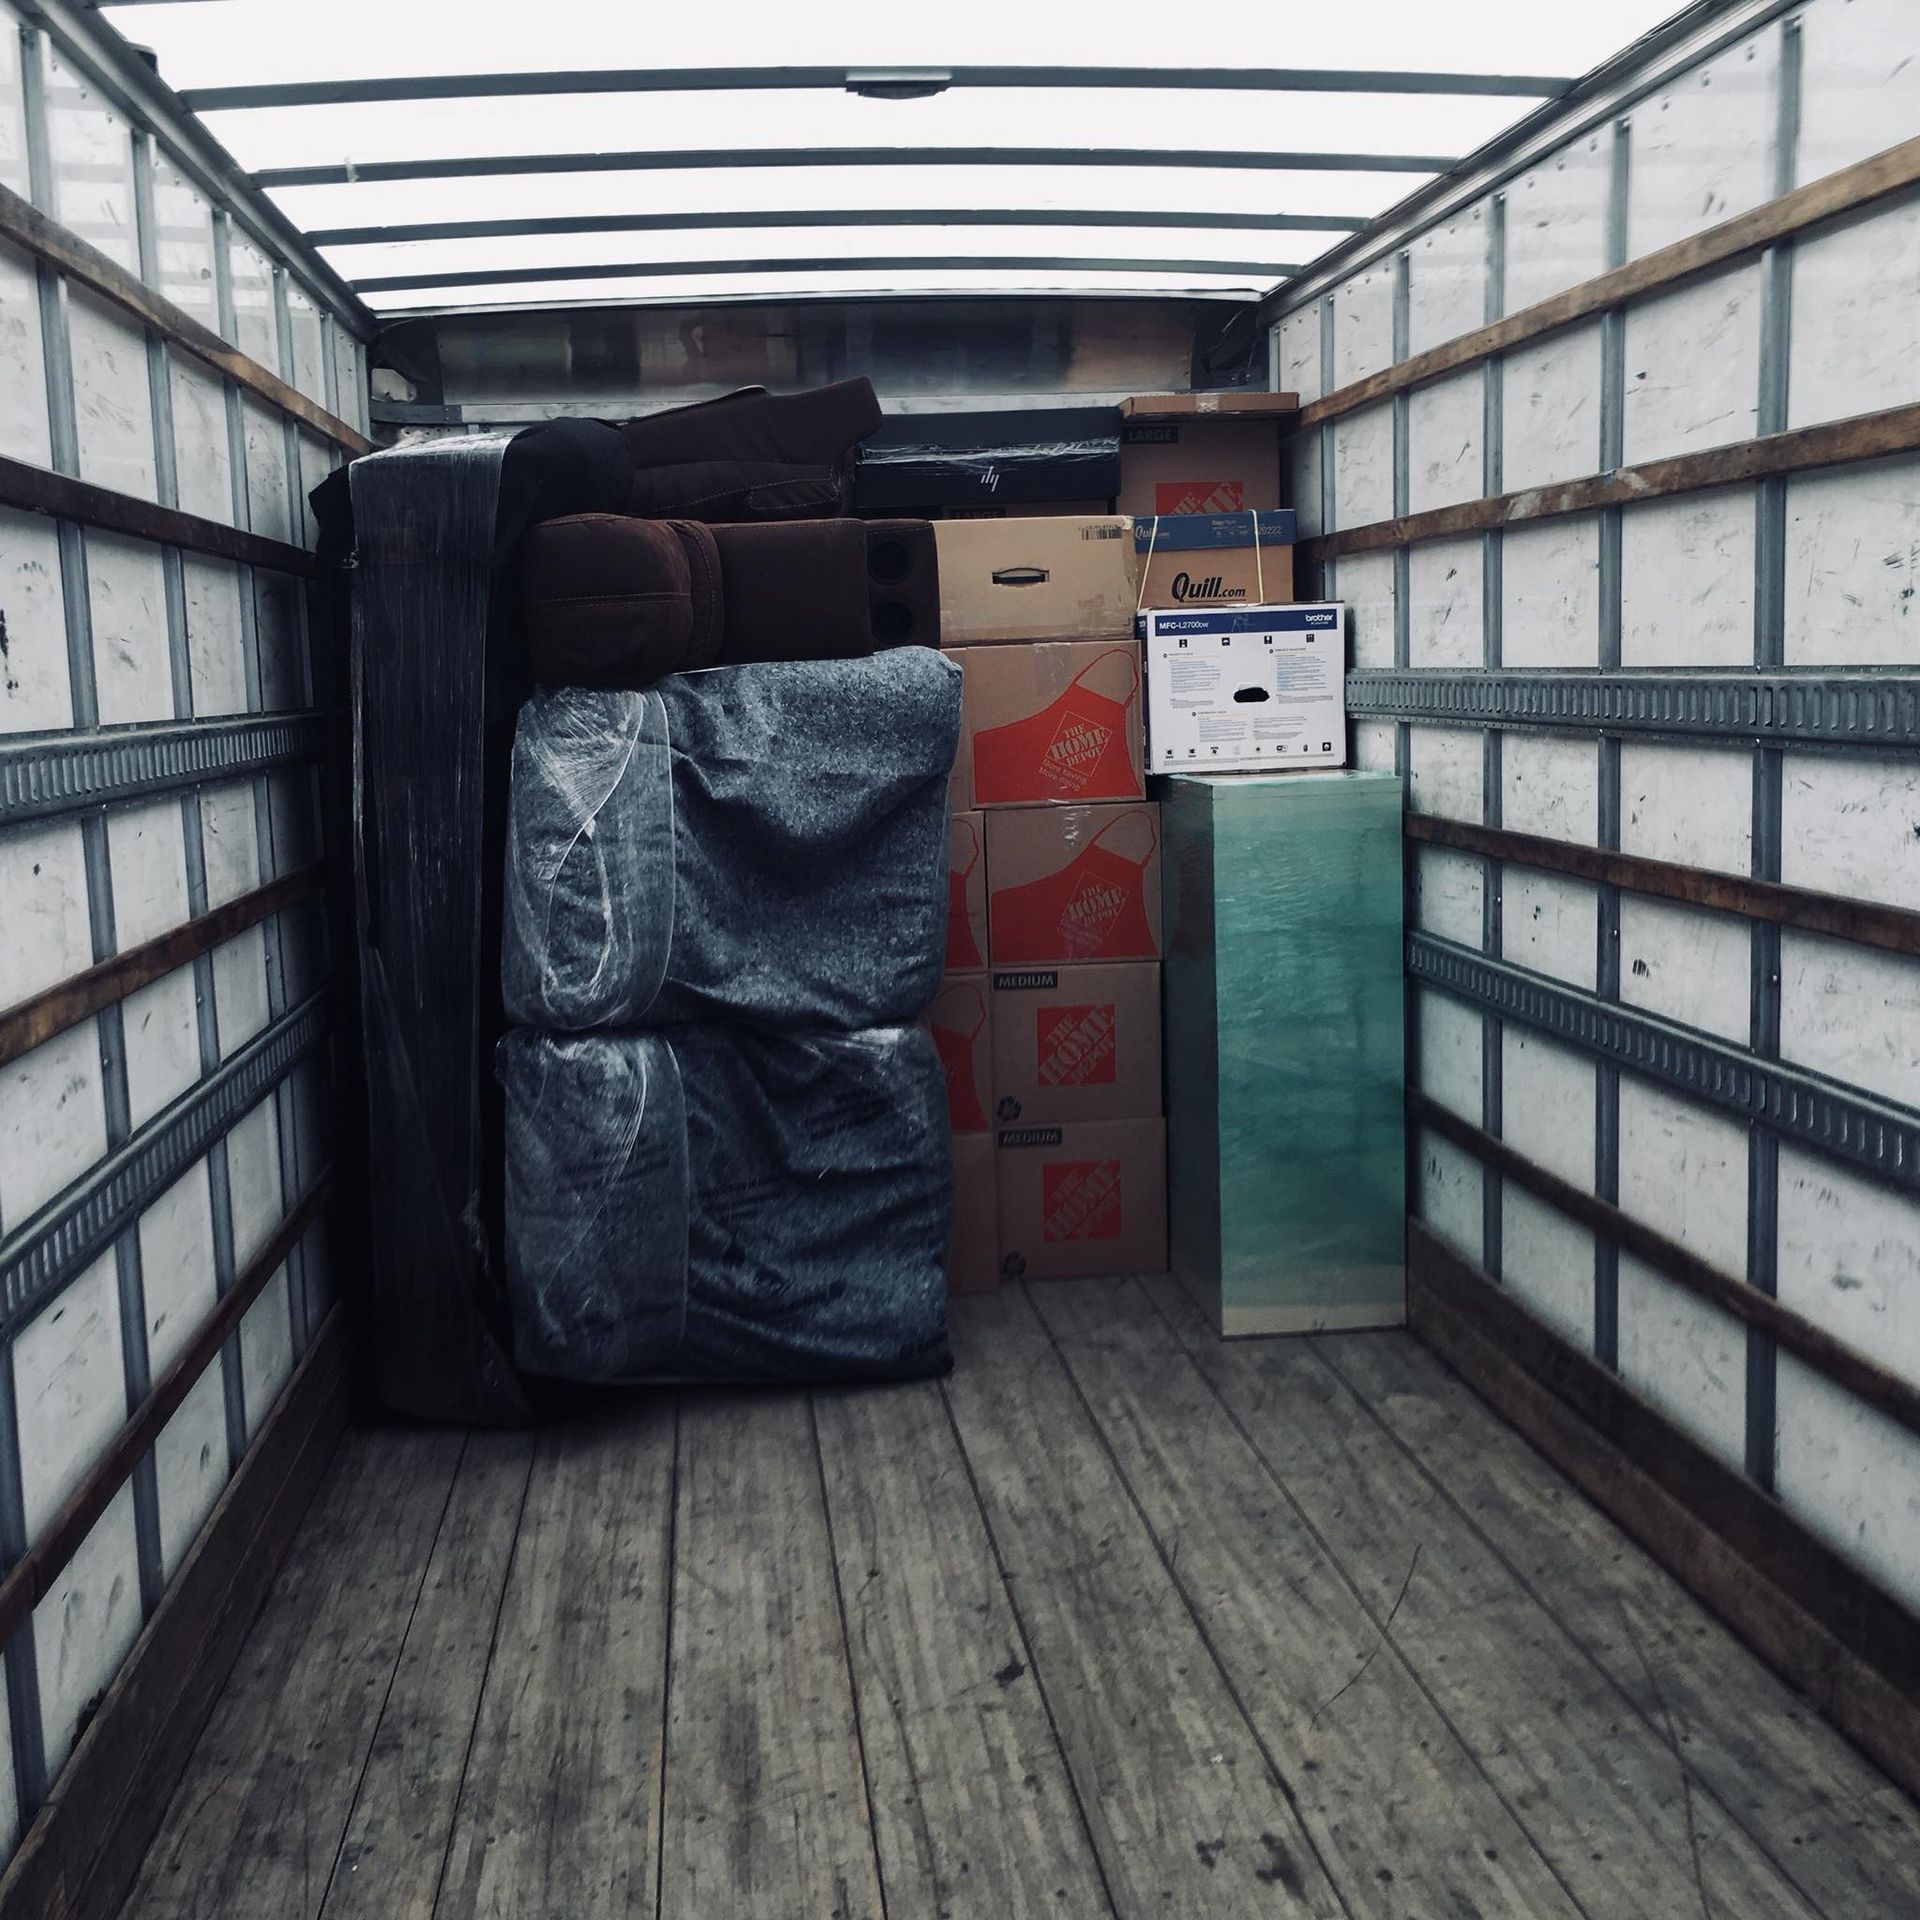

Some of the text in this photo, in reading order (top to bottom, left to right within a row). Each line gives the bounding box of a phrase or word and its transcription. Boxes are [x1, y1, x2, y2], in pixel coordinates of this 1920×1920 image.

[1128, 428, 1173, 441] LARGE
[1171, 572, 1247, 602] Quill.com
[1304, 613, 1334, 622] brother
[1063, 723, 1087, 738] THE
[1050, 726, 1109, 761] HOME
[1066, 745, 1102, 767] DEPOT
[1067, 886, 1124, 922] HOME
[998, 974, 1055, 988] MEDIUM
[1038, 1004, 1113, 1086] HOME
[1002, 1130, 1059, 1145] MEDIUM
